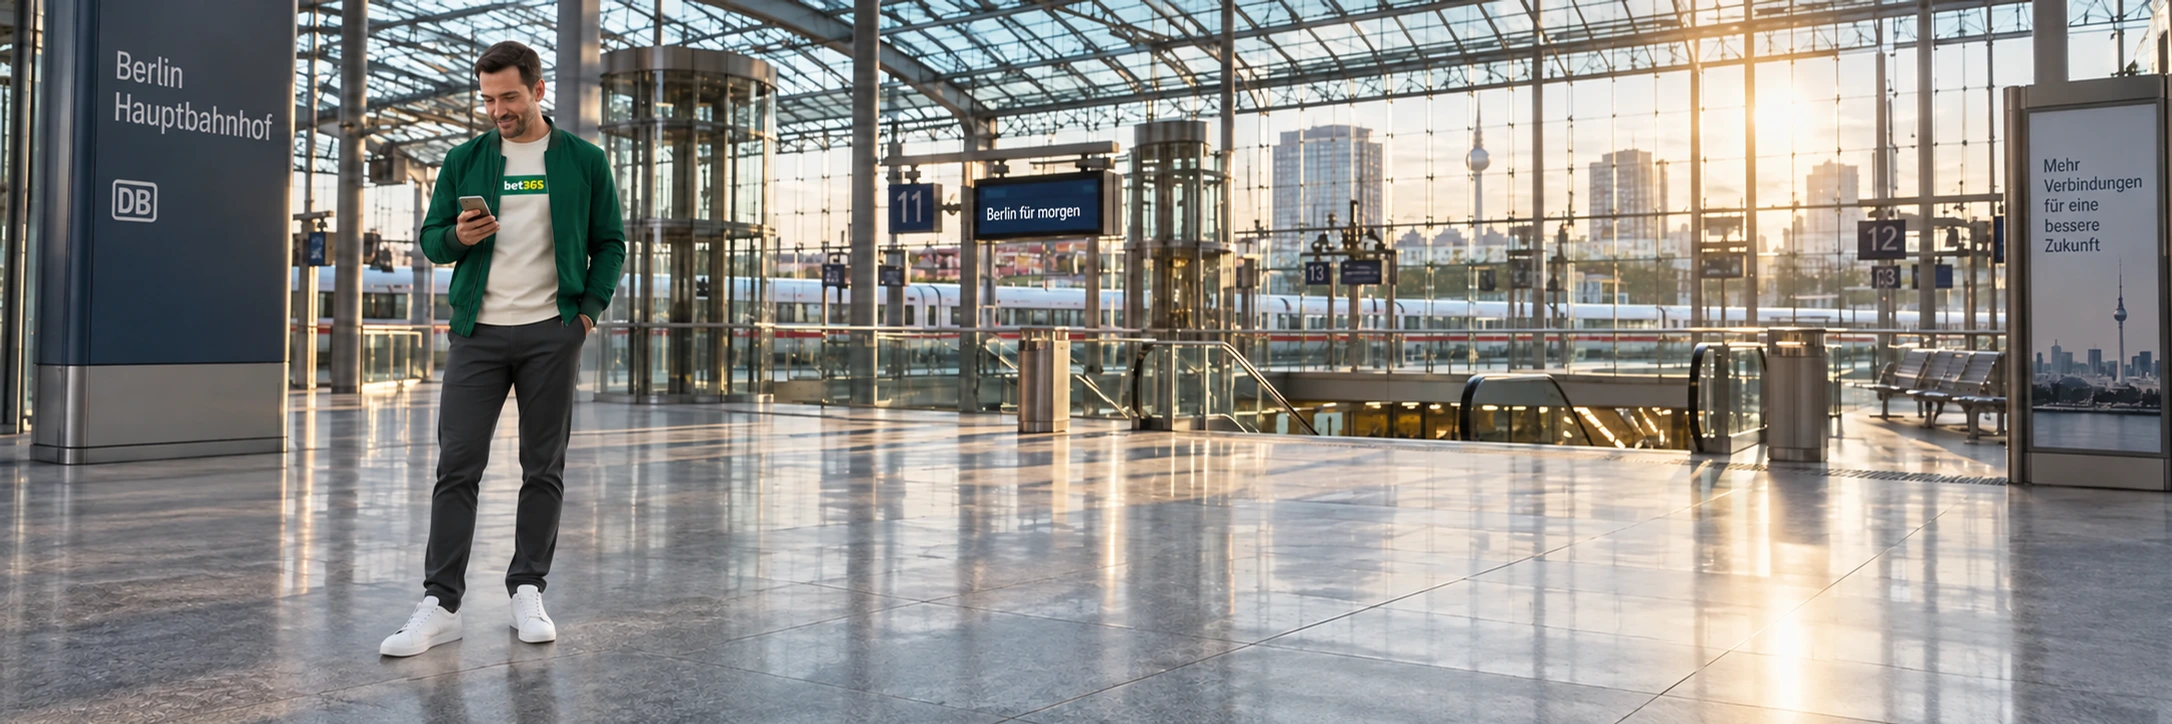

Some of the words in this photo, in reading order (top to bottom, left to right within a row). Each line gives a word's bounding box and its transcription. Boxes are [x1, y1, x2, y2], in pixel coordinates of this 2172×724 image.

[116, 50, 183, 89] Berlin
[115, 92, 273, 141] Hauptbahnhof
[2044, 157, 2080, 173] Mehr
[503, 180, 545, 191] bet365
[2044, 176, 2142, 193] Verbindungen
[117, 187, 152, 215] DB
[897, 190, 922, 223] 11
[2044, 198, 2065, 213] für
[2068, 198, 2099, 212] eine
[986, 206, 1017, 222] Berlin
[1019, 205, 1036, 220] für
[1037, 205, 1081, 222] morgen
[2045, 218, 2100, 233] bessere
[1867, 225, 1898, 252] 12
[2045, 237, 2101, 253] Zukunft
[1308, 264, 1324, 281] 13
